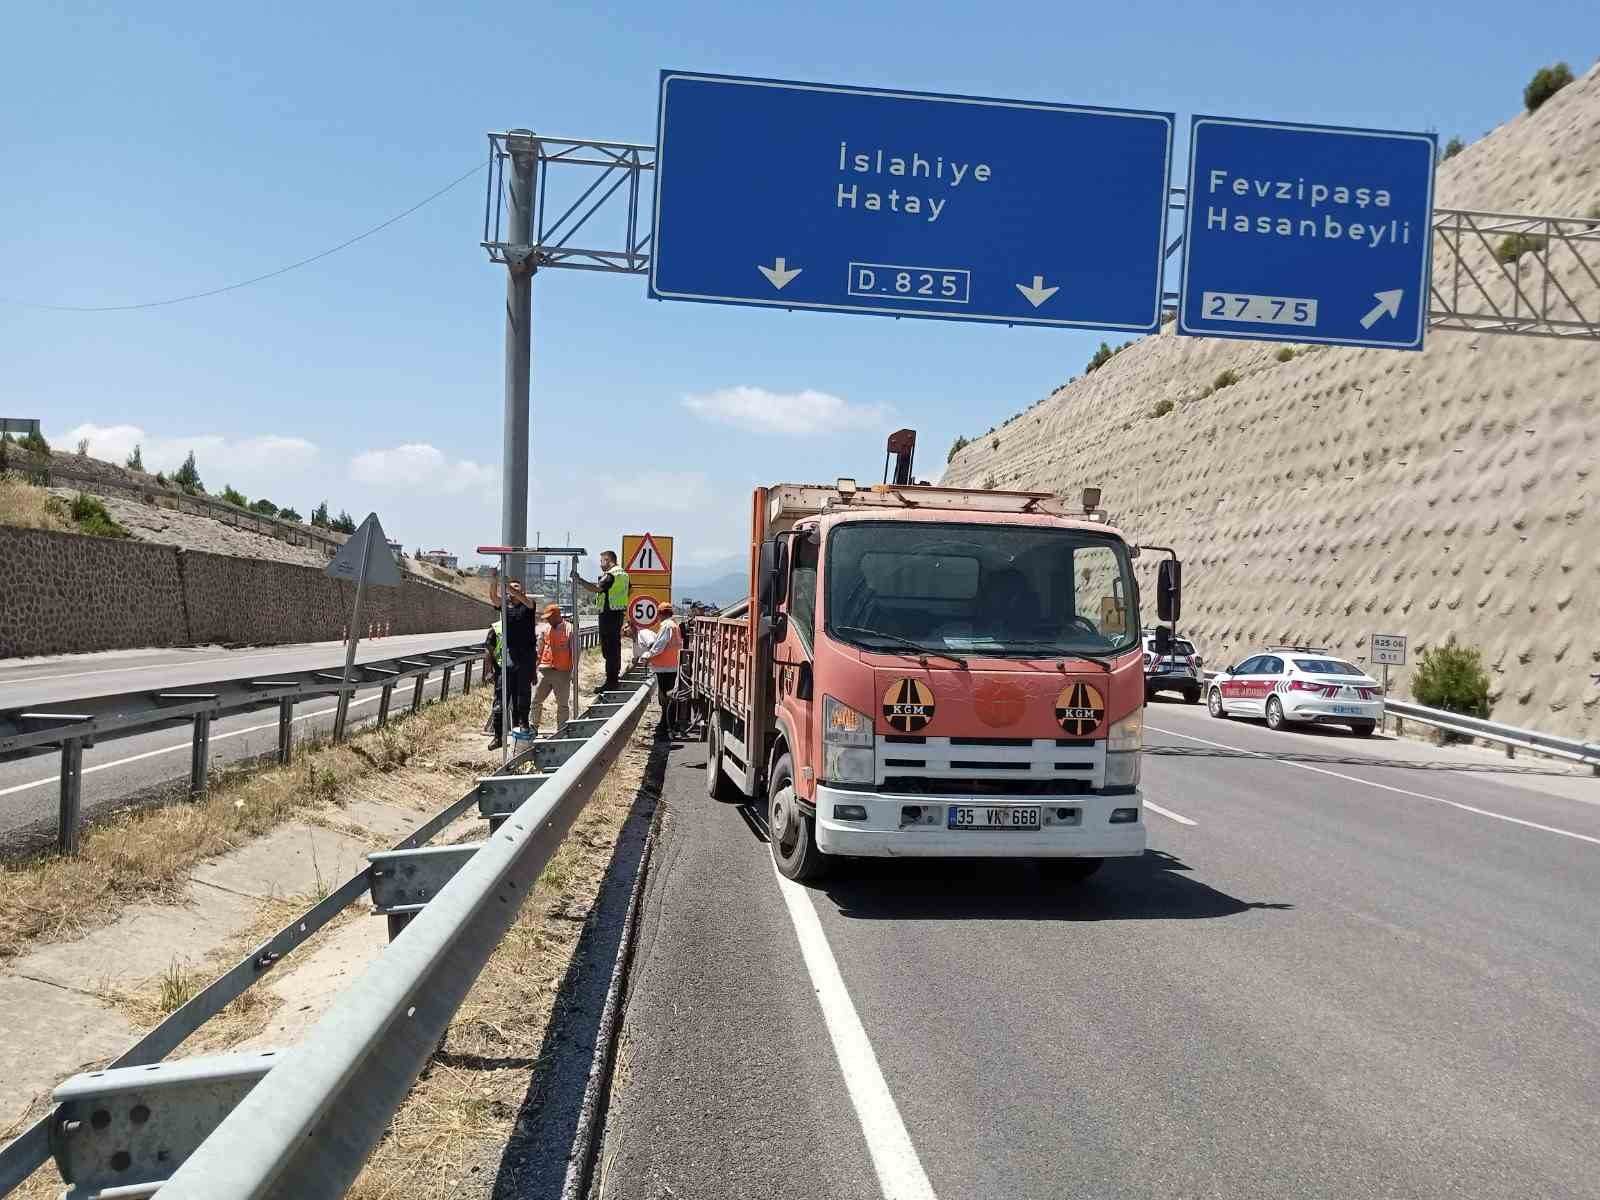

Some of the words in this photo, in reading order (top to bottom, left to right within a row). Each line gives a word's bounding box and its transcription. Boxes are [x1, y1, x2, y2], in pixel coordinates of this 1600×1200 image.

[839, 141, 992, 187] İslahiye
[1209, 169, 1391, 209] Fevzipaşa
[837, 183, 946, 222] Hatay
[1207, 206, 1409, 248] Hasanbeyli
[858, 269, 958, 296] D.825
[1210, 296, 1309, 322] 27.75
[635, 604, 656, 619] 50
[893, 705, 924, 715] KGM
[1065, 709, 1094, 718] KGM
[958, 809, 974, 825] 35
